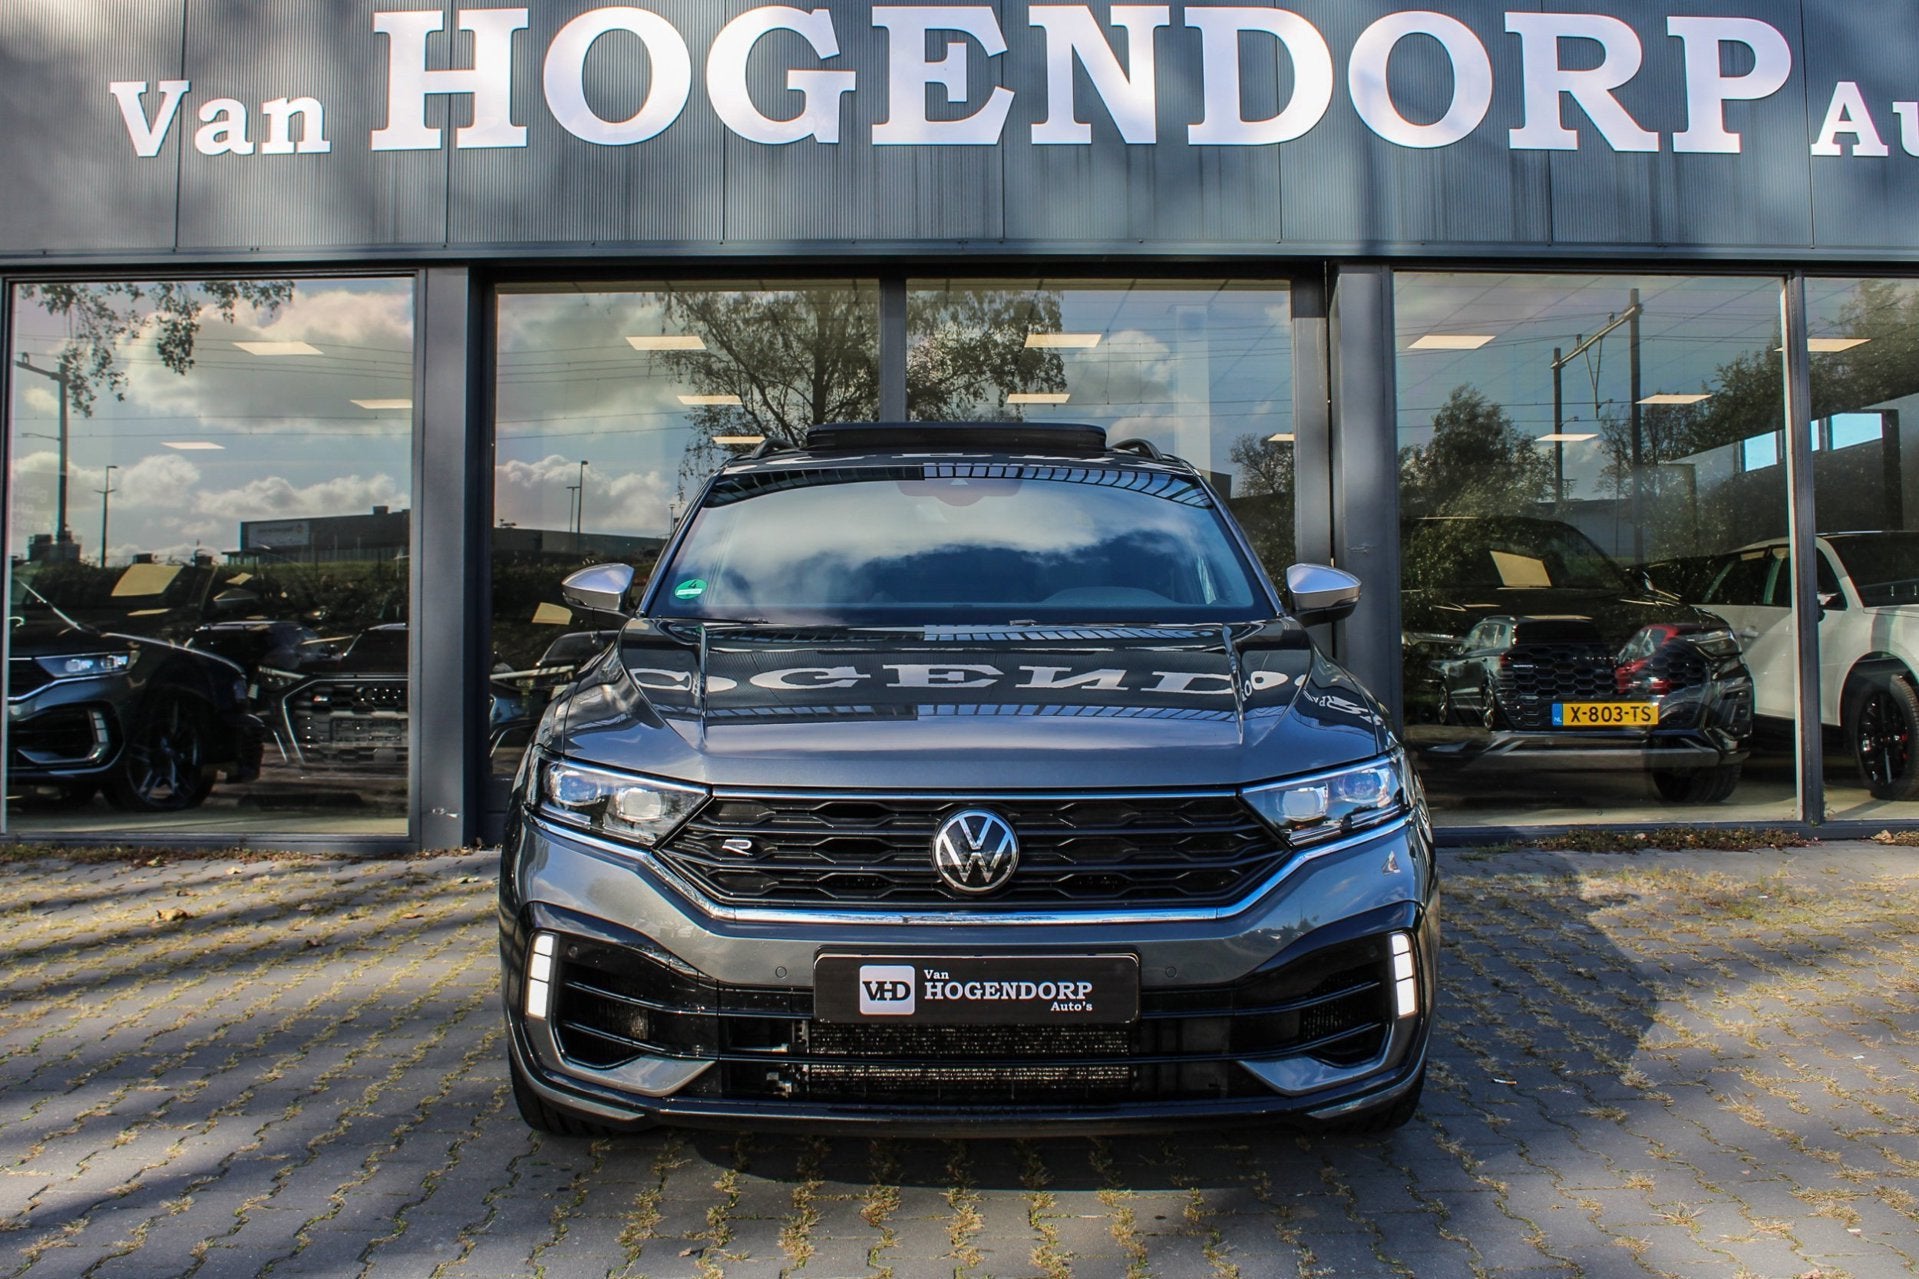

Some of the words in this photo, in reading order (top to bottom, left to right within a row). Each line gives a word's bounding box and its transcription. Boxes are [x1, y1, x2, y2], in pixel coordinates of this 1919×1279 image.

[110, 80, 331, 157] Van
[370, 4, 1792, 153] HOGENDORP
[1570, 706, 1651, 722] X-803-TS
[924, 969, 949, 980] Van
[924, 981, 1093, 1000] HOGENDORP
[1050, 1001, 1093, 1012] Auto's
